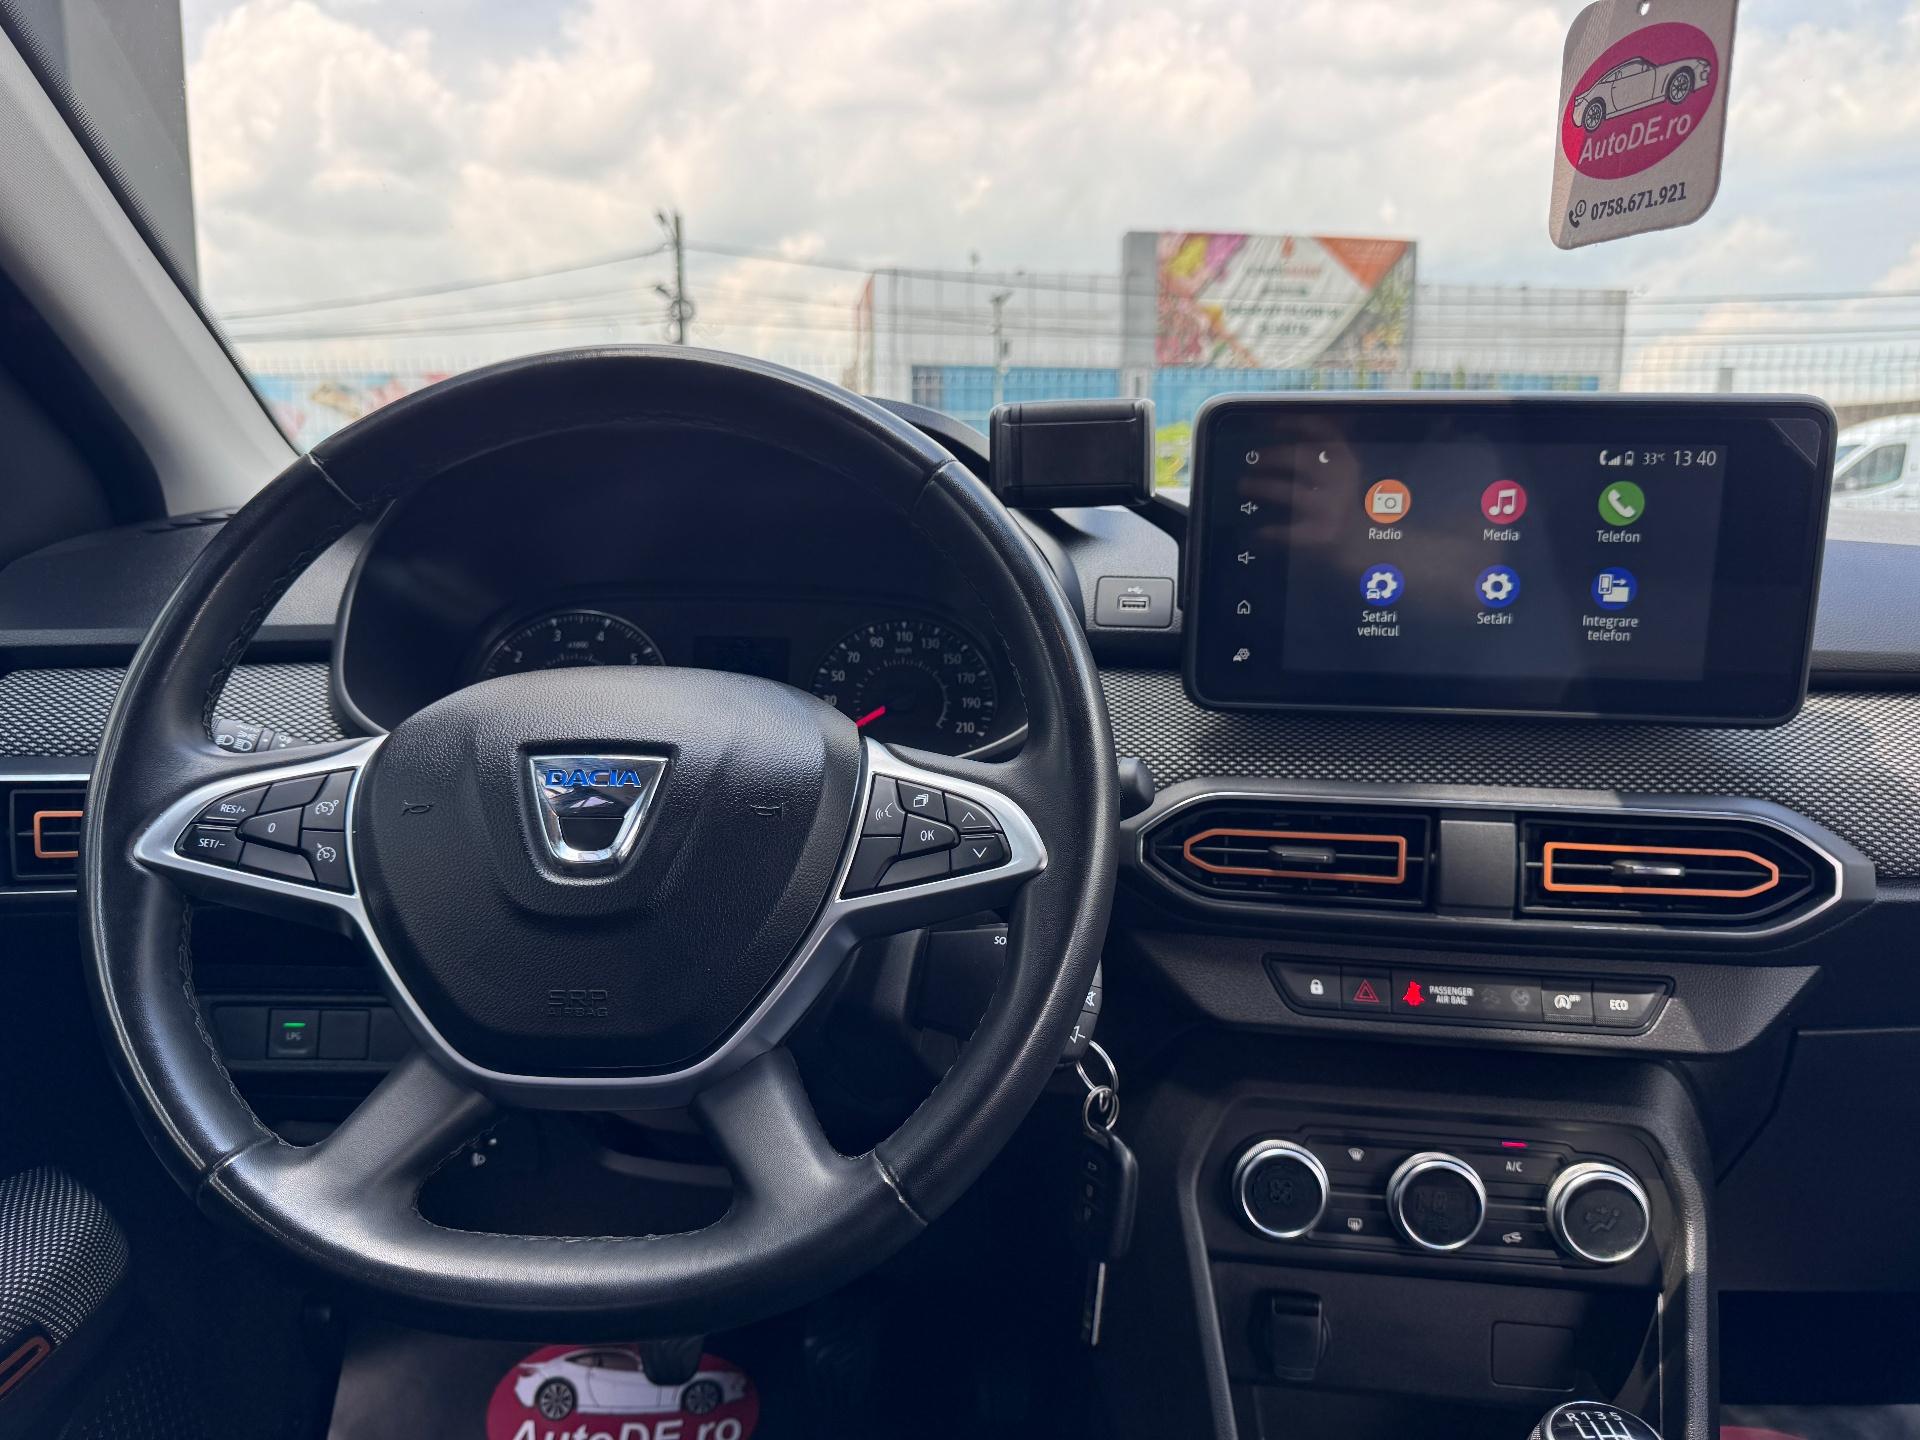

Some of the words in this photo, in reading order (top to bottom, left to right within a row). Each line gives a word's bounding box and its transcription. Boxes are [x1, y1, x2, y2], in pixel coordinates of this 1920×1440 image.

[1578, 114, 1692, 165] AutoDE.ro
[1590, 182, 1687, 221] 0758.671.921
[1673, 450, 1693, 467] 13
[1696, 450, 1717, 467] 40
[1368, 527, 1402, 541] Radio
[1483, 528, 1520, 542] Media
[1596, 530, 1641, 544] Telefon
[1361, 610, 1397, 623] Setări
[1476, 612, 1513, 625] Setări
[1582, 614, 1639, 630] Integrare
[553, 629, 562, 642] 3
[595, 629, 605, 642] 4
[896, 631, 913, 643] 110
[1357, 625, 1400, 638] vehicul
[1587, 629, 1631, 642] telefon
[869, 637, 884, 648] 90
[921, 637, 940, 649] 130
[513, 652, 523, 664] 2
[630, 653, 638, 665] 5
[847, 652, 860, 664] 70
[943, 654, 962, 666] 150
[831, 670, 846, 683] 50
[957, 673, 975, 685] 170
[962, 697, 981, 710] 190
[955, 721, 975, 735] 210
[545, 768, 642, 788] DACIA
[219, 802, 247, 814] RES/+
[919, 829, 935, 842] OK
[993, 935, 1007, 945] SO
[1429, 985, 1475, 997] PASSENGER
[1435, 994, 1449, 1004] AIR
[1450, 995, 1469, 1006] BAG
[1609, 999, 1630, 1011] ECO
[1505, 1160, 1523, 1173] A/C
[1565, 1411, 1580, 1422] R
[1581, 1411, 1591, 1421] 1
[1594, 1411, 1607, 1421] 3
[1609, 1411, 1622, 1421] 5
